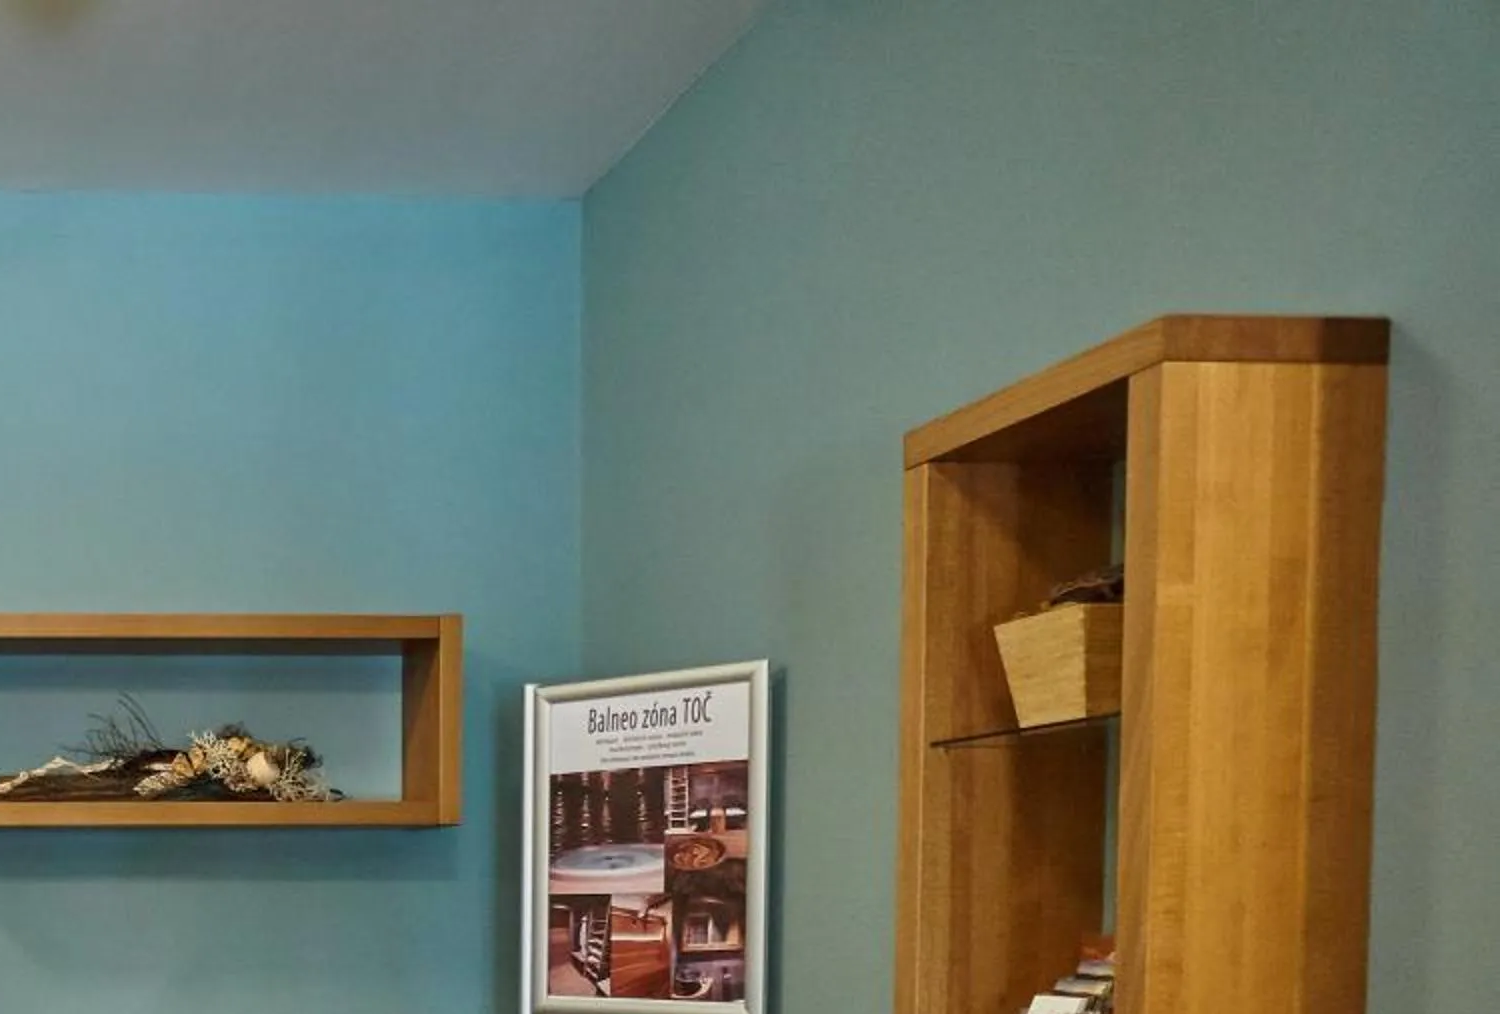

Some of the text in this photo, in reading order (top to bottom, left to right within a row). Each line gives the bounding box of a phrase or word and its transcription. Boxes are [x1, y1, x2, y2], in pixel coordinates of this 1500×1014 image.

[588, 691, 713, 734] Balneo zóna TOČ
